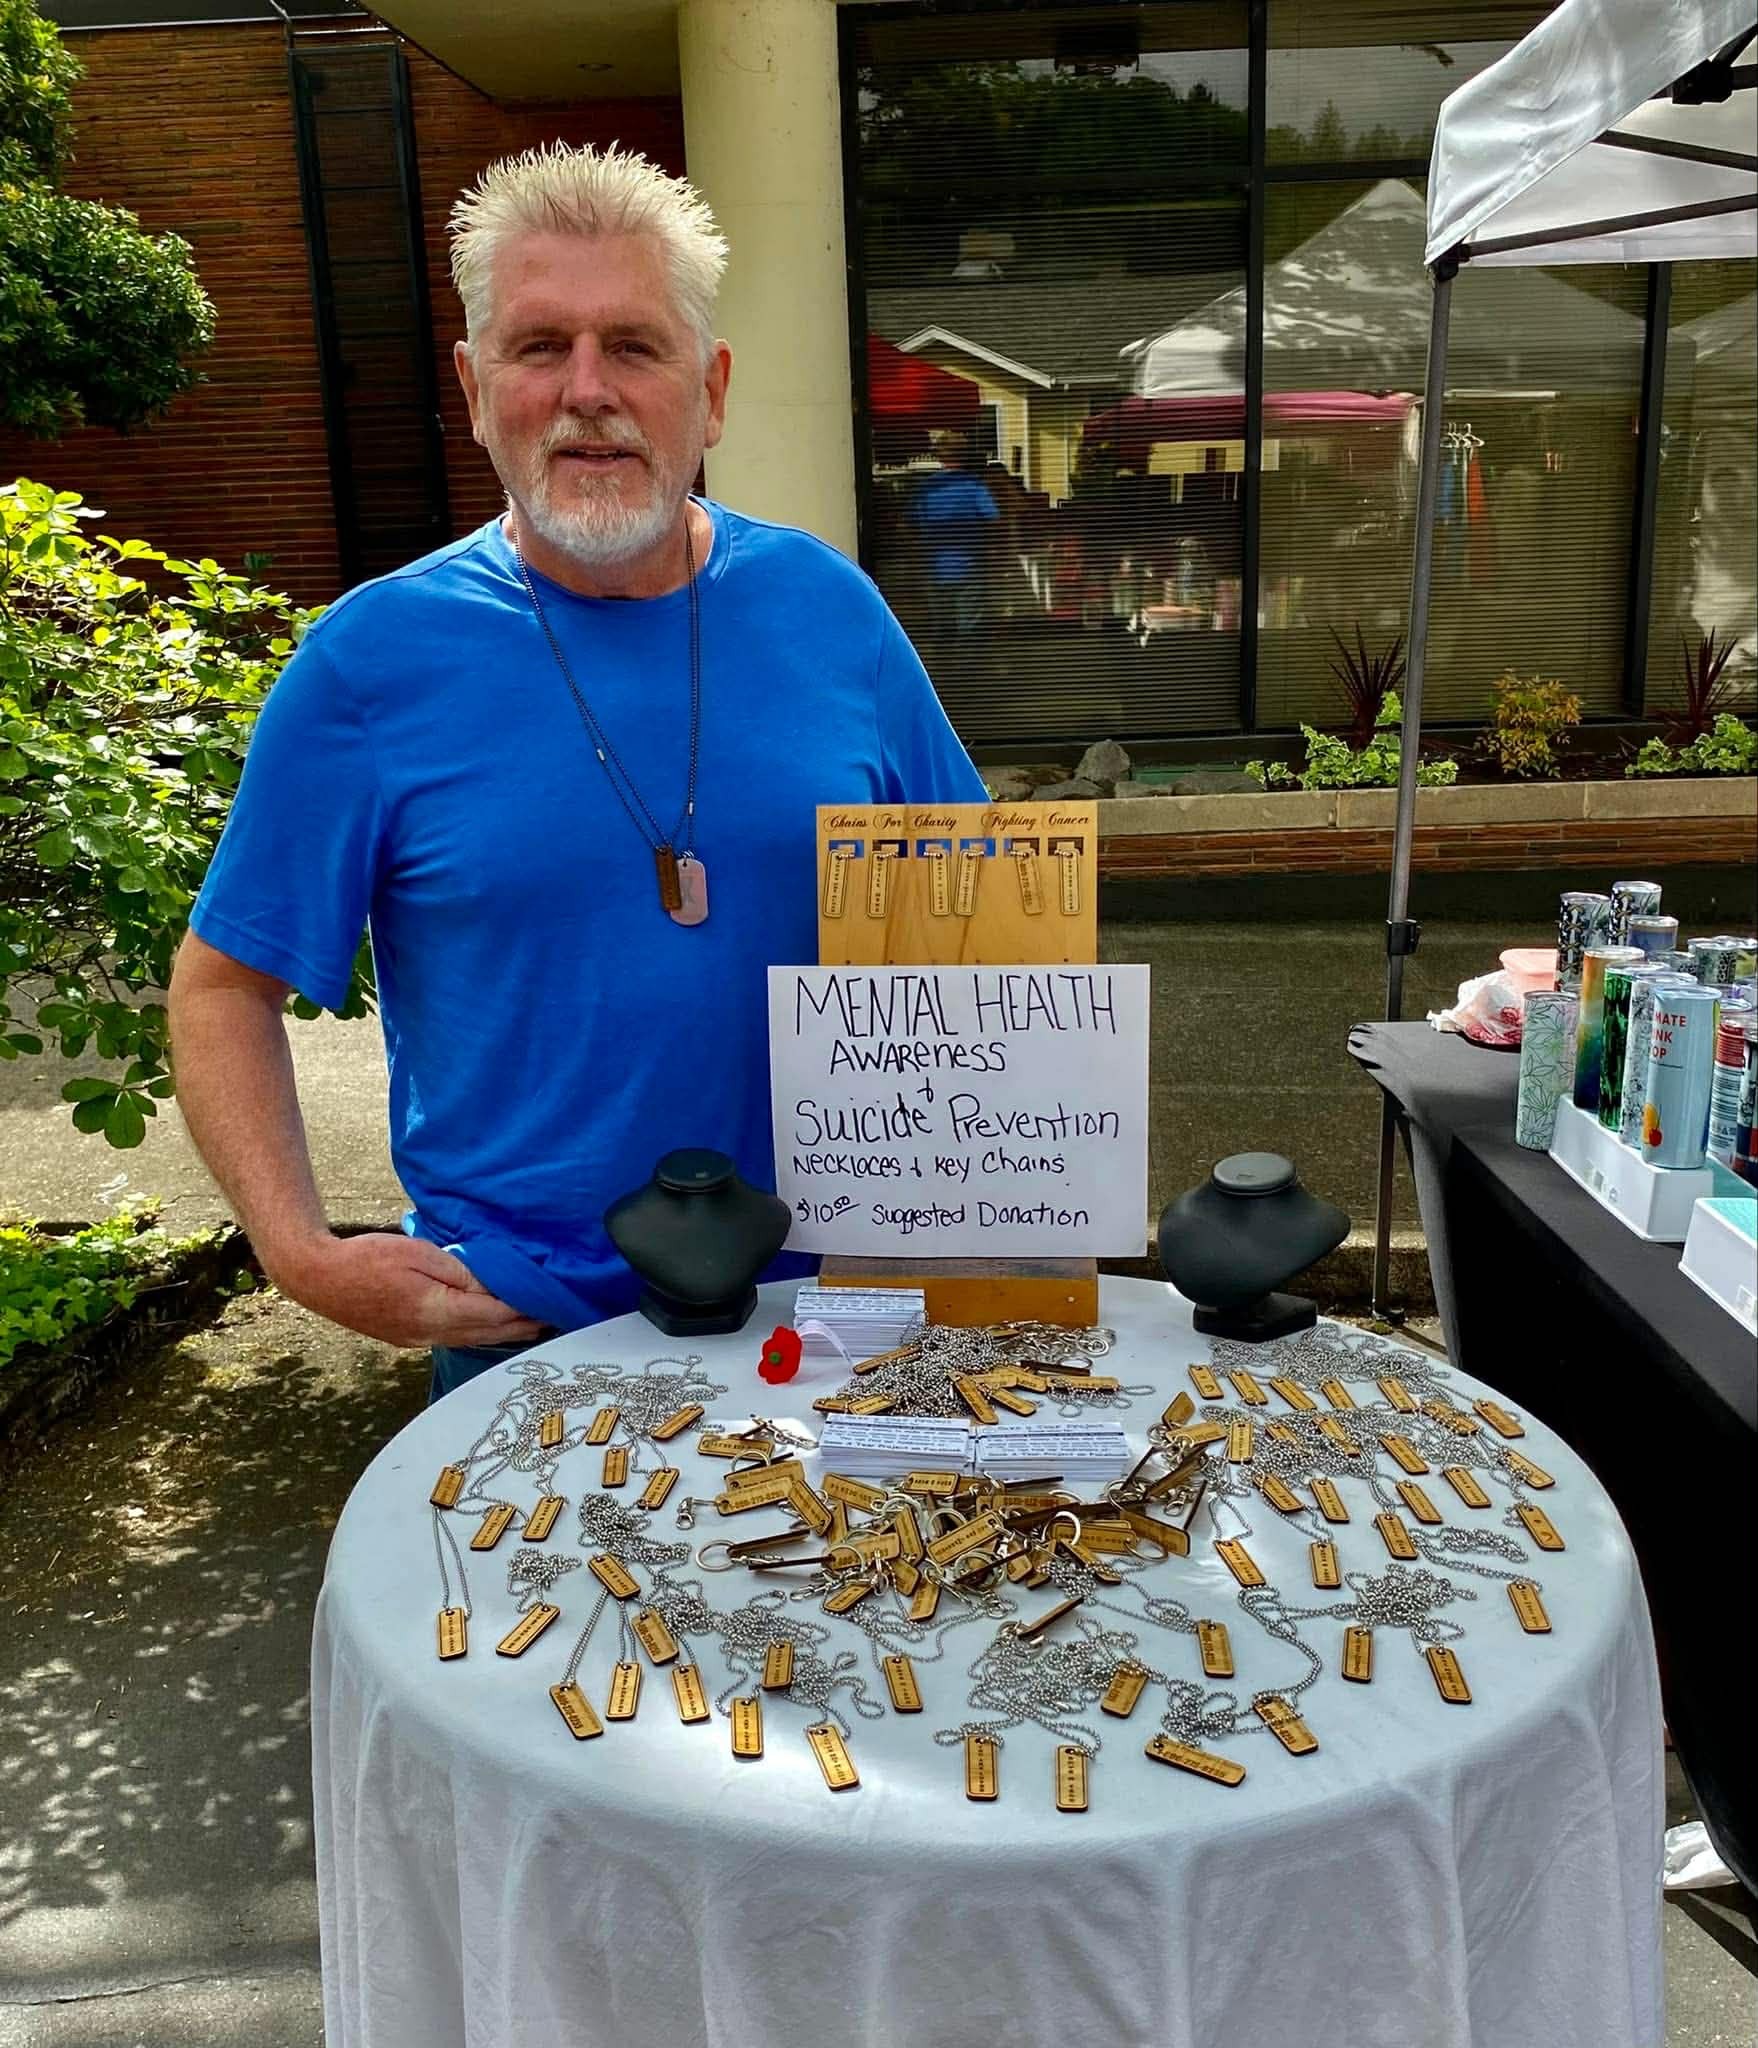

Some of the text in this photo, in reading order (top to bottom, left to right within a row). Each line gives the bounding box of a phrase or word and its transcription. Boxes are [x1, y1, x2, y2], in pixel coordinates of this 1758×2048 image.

[824, 811, 1090, 832] Chains For Charity Fighting Cancer
[796, 973, 1116, 1037] MENTAL HEALTH
[795, 1090, 1120, 1146] Suicide Prevention
[981, 1146, 1065, 1174] Chains
[871, 1201, 966, 1235] Suggested
[977, 1201, 1089, 1228] Donation
